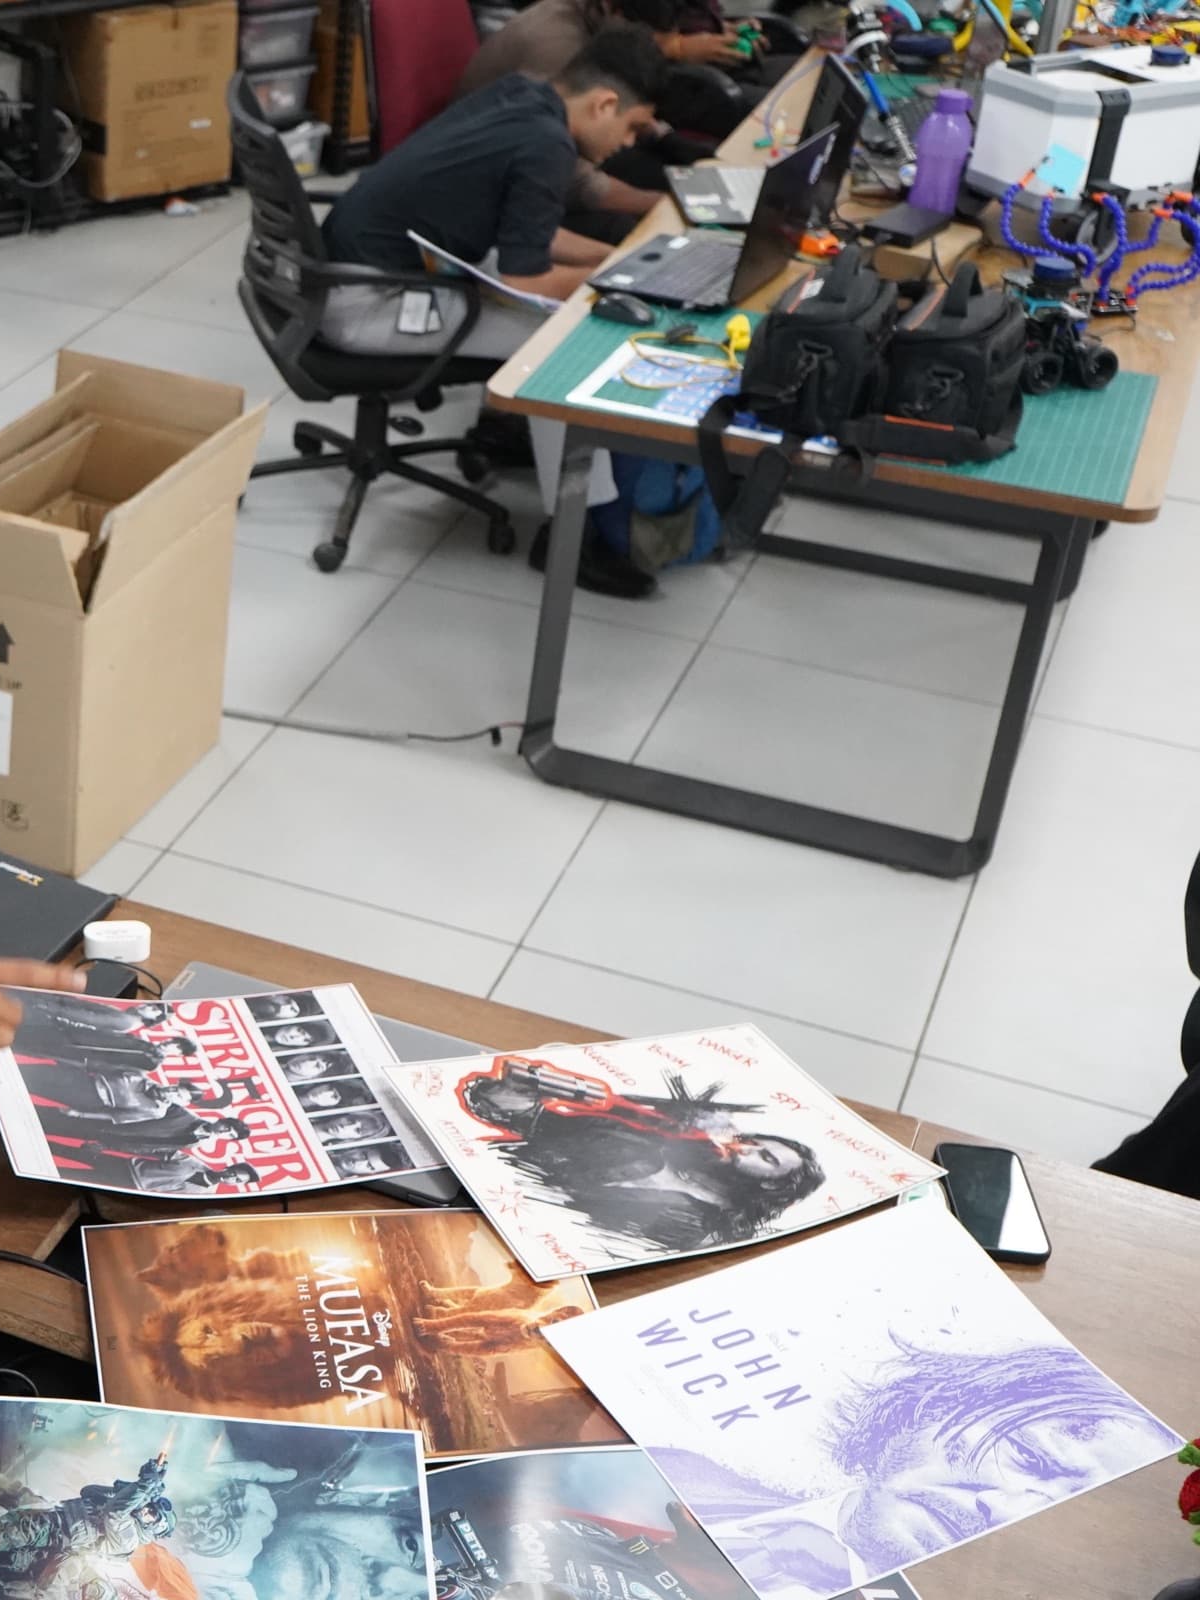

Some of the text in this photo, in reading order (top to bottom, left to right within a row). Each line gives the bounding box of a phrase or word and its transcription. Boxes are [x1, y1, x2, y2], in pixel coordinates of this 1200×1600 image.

[295, 1273, 333, 1389] THE LION KING
[309, 1254, 388, 1416] MUFASA
[636, 1318, 760, 1431] WICK
[689, 1309, 812, 1411] JOHN
[457, 1522, 499, 1579] PETRN
